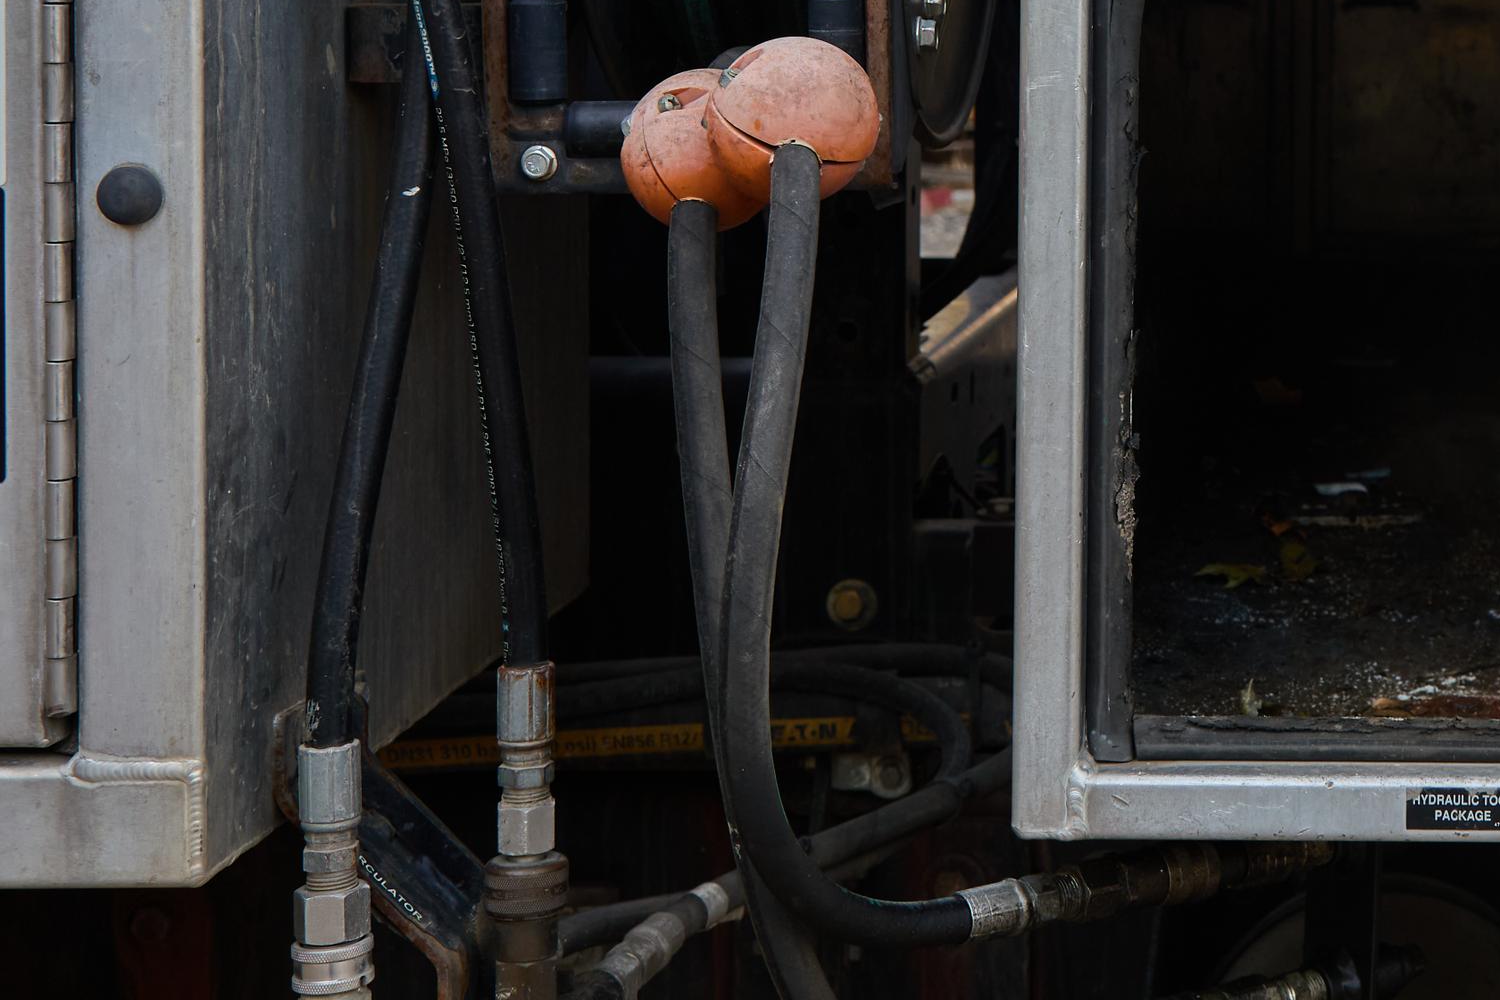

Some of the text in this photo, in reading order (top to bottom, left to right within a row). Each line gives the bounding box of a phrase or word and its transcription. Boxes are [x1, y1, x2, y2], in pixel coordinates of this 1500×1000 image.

[1412, 794, 1479, 806] HYDRAULIC
[1434, 809, 1491, 821] PACKAGE
[357, 853, 423, 923] RCULATOR
